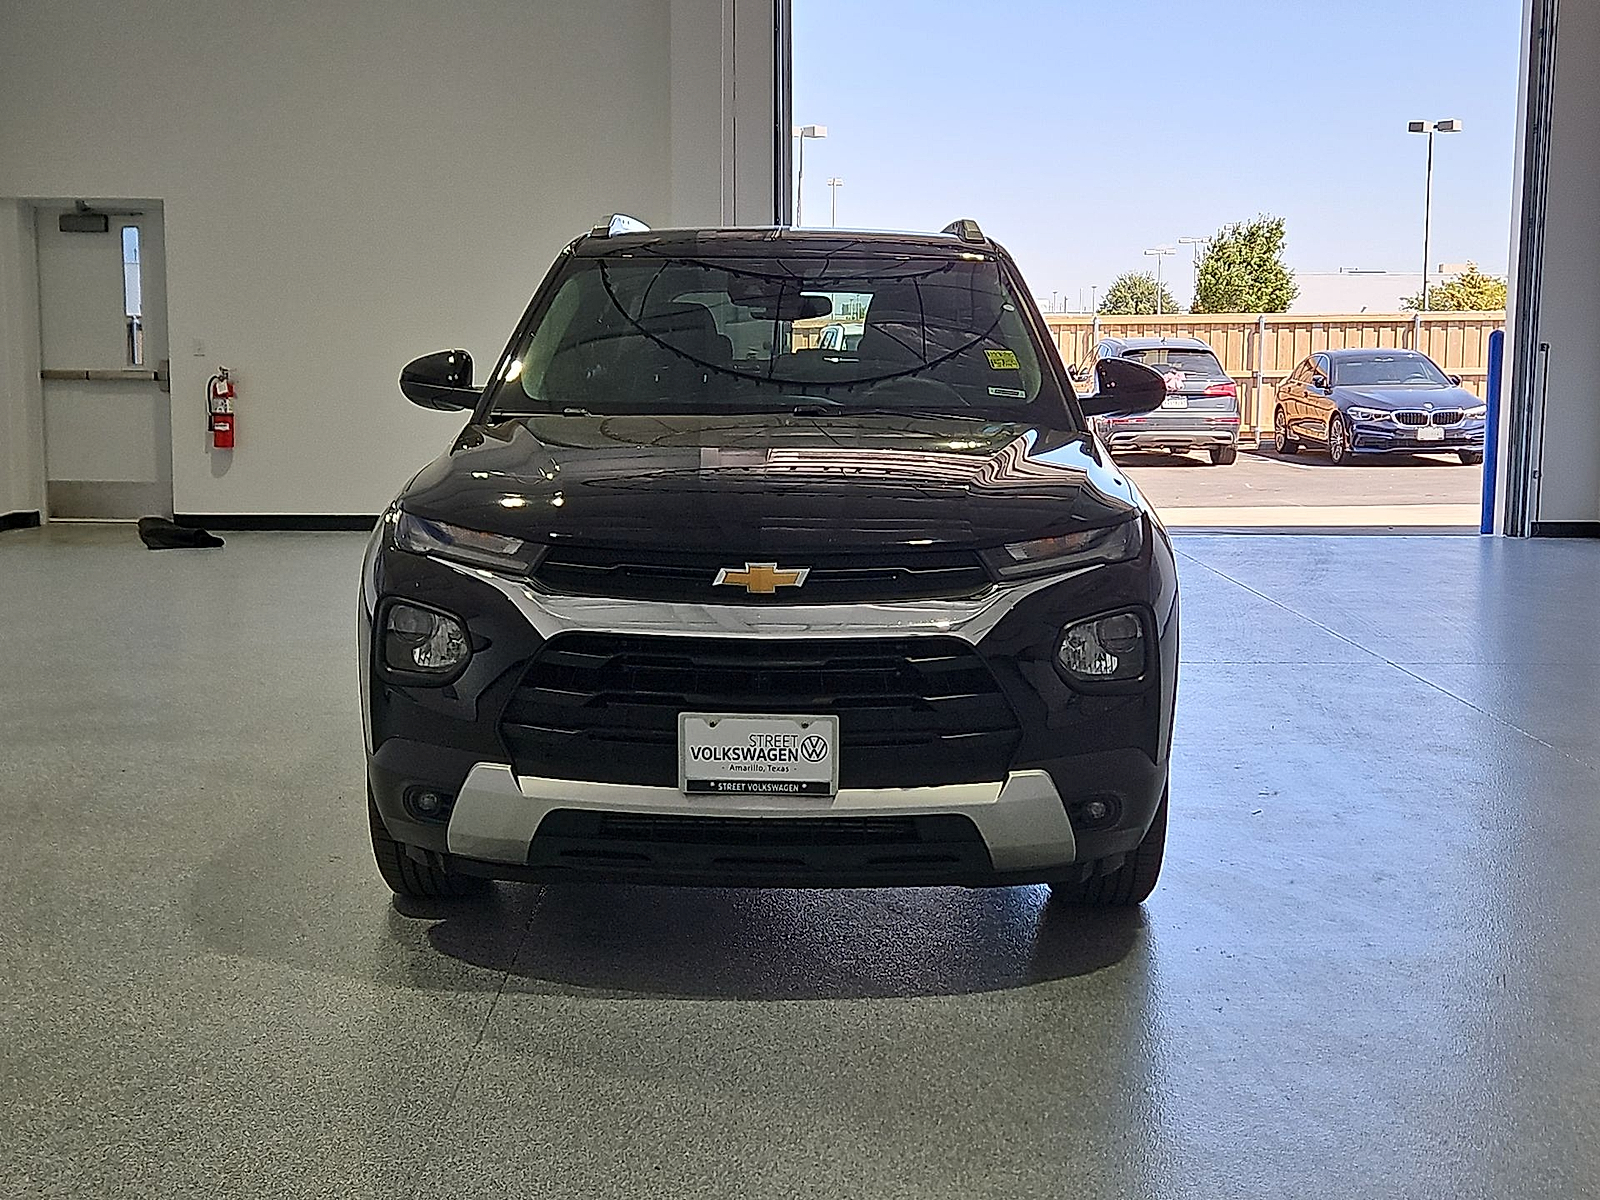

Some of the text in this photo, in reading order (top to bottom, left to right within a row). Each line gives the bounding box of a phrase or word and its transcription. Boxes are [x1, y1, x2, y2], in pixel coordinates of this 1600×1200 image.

[749, 734, 799, 748] STREET
[690, 746, 799, 762] VOLKSWAGEN
[729, 764, 790, 773] Amarillo, Texas
[718, 782, 799, 792] STREET VOLKSWAGEN
